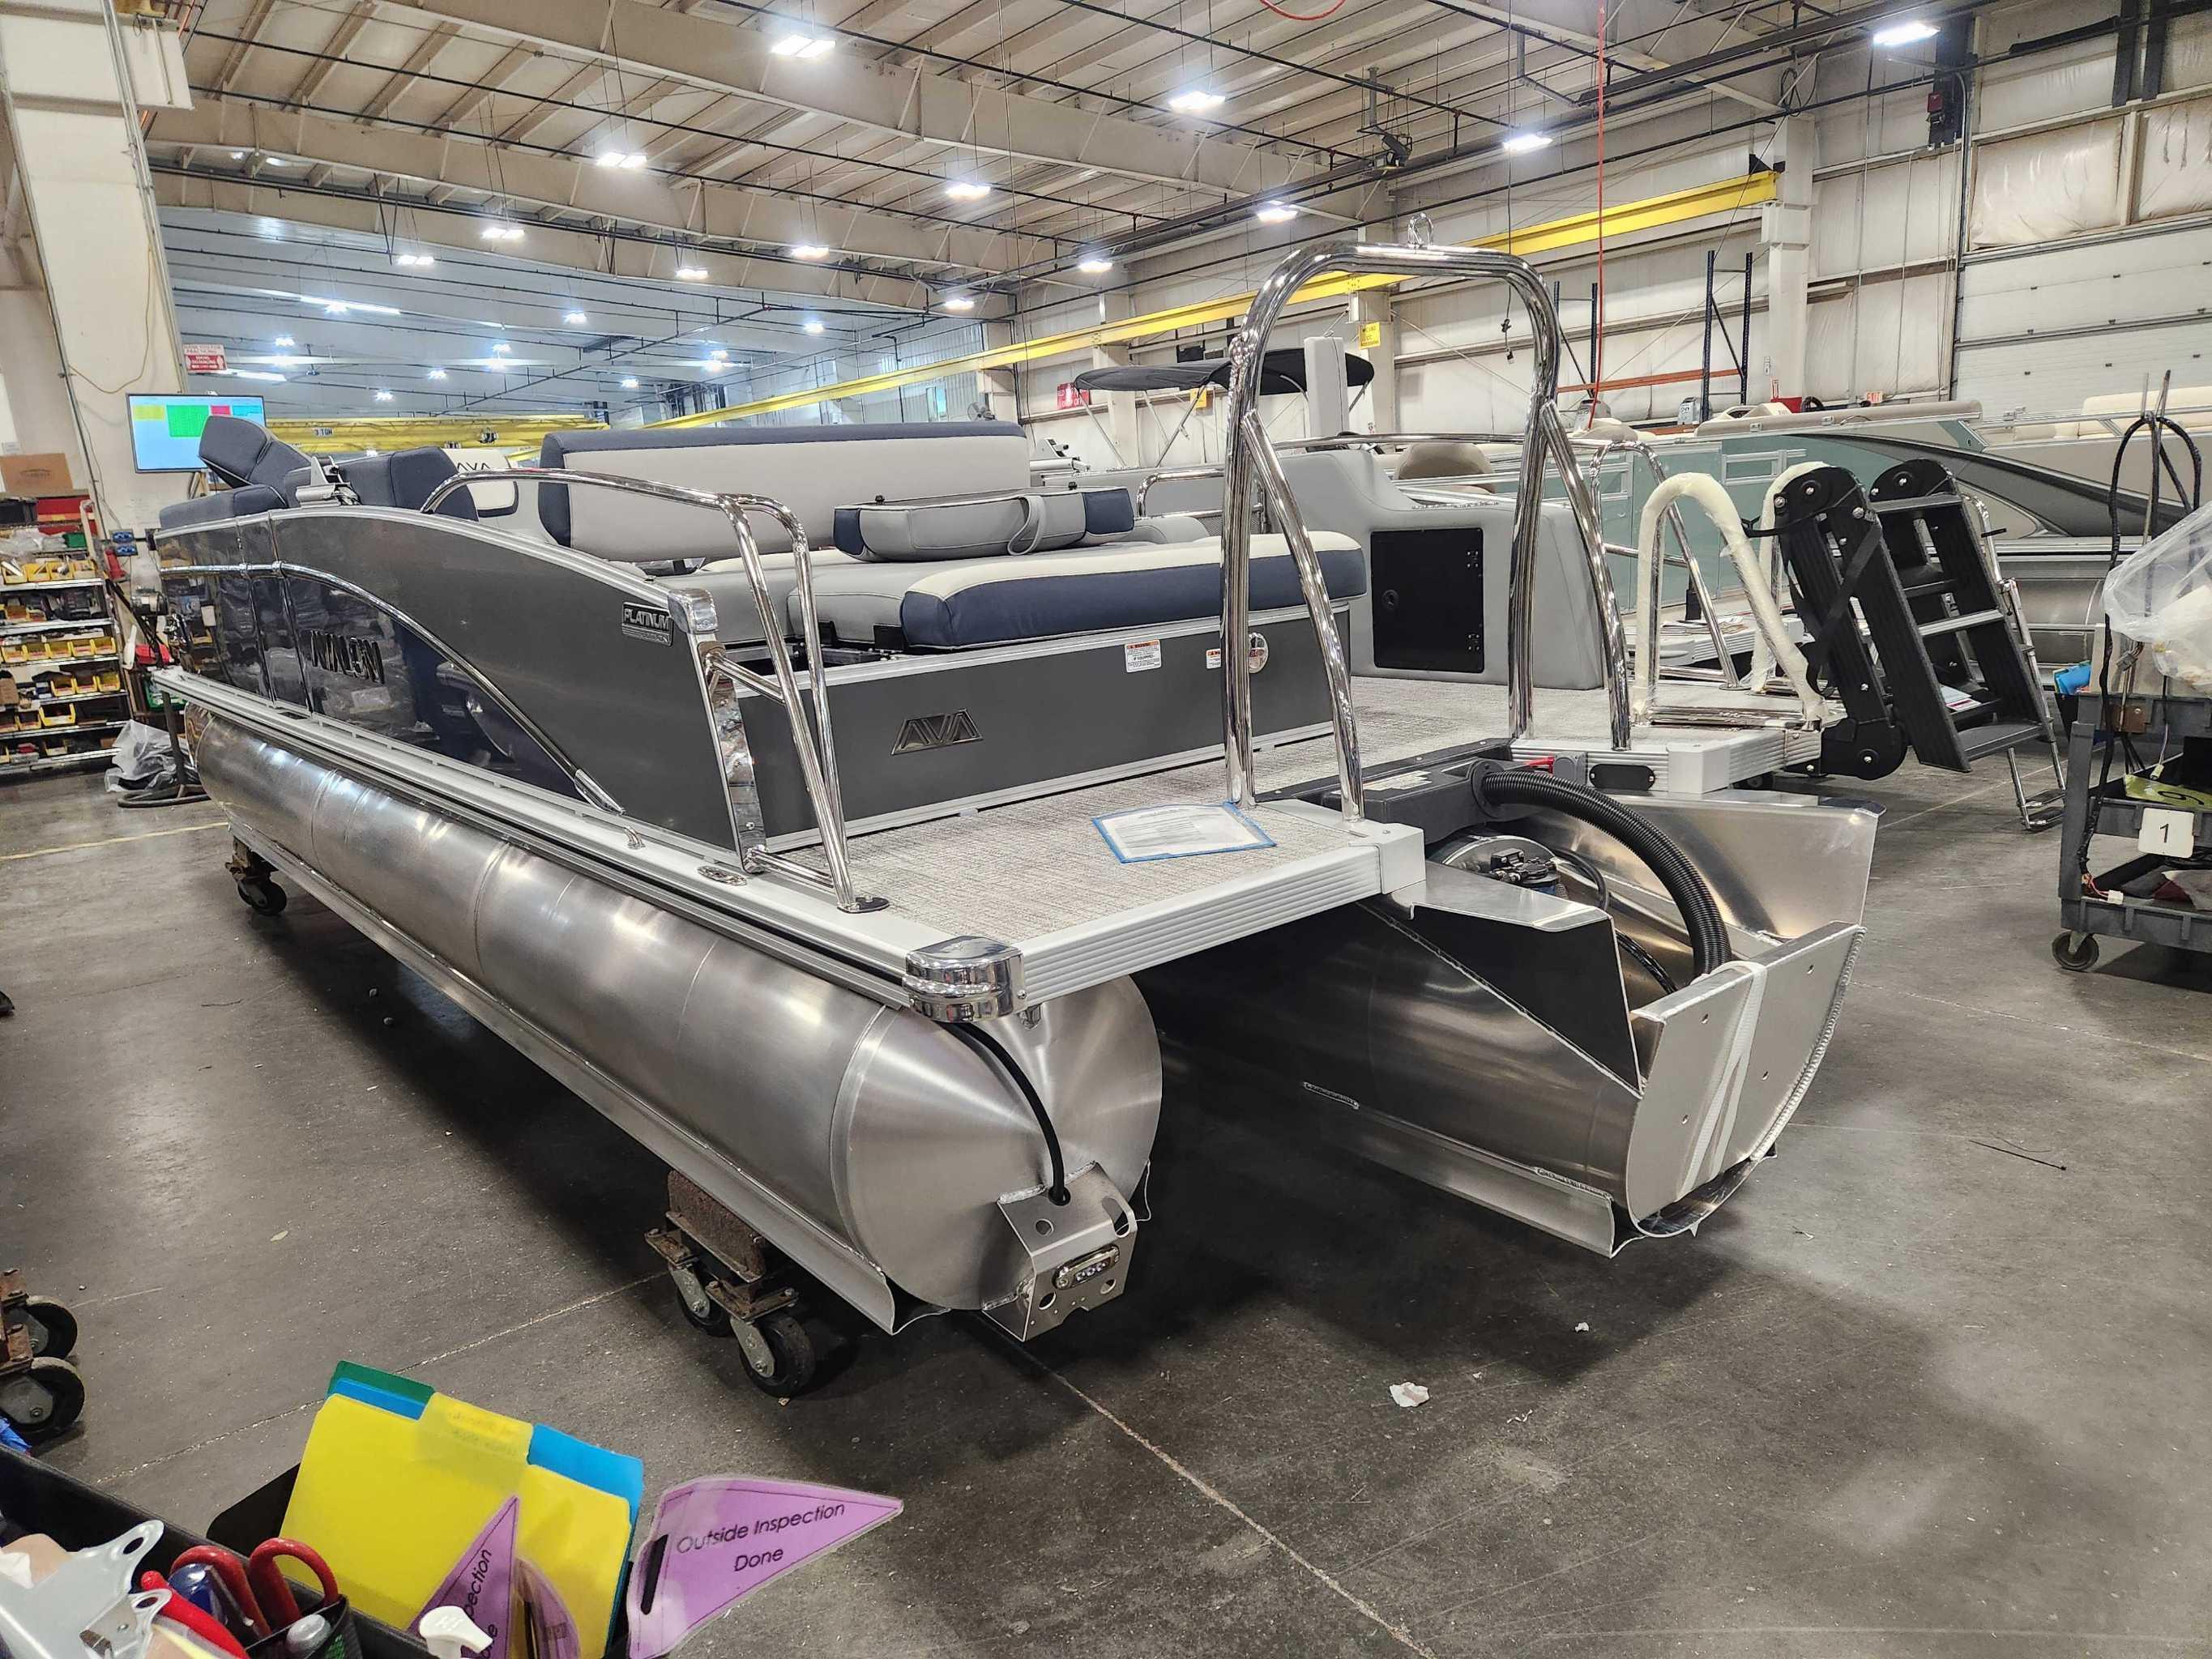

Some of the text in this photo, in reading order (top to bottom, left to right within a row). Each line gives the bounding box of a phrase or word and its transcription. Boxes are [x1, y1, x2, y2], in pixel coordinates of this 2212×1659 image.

[624, 608, 671, 631] PLATINUM
[891, 708, 984, 756] AVA
[2159, 823, 2169, 843] 1
[676, 1503, 845, 1555] Outside Inspection
[734, 1548, 784, 1572] Done
